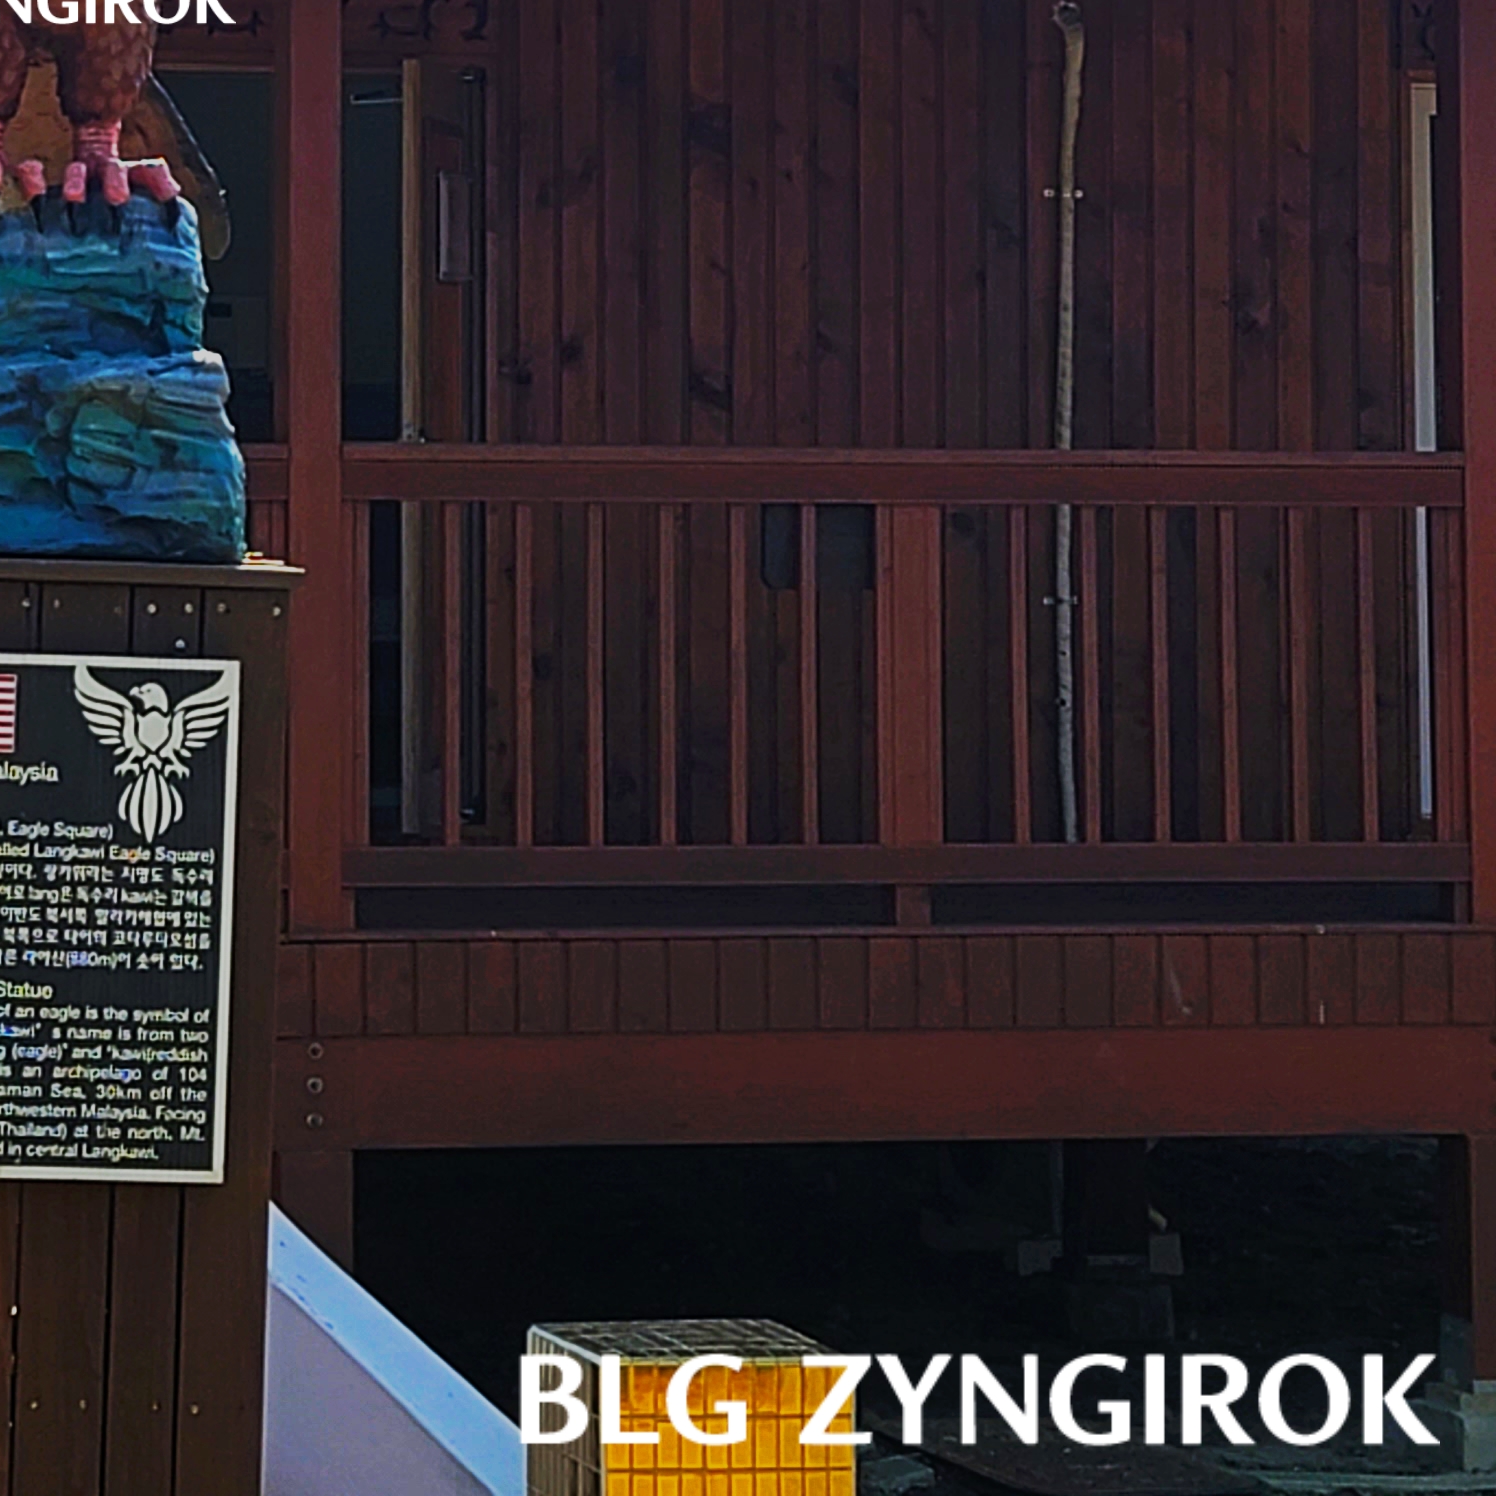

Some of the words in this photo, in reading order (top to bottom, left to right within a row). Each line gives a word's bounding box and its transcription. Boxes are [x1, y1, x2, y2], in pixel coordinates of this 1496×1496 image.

[8, 820, 50, 839] Eagle
[53, 822, 114, 841] Square)
[33, 843, 104, 862] Langkawi
[109, 845, 151, 864] Eagle
[155, 846, 215, 865] Square)
[14, 1007, 36, 1019] an
[39, 1005, 82, 1023] eagle
[85, 1006, 99, 1021] is
[103, 1007, 129, 1022] the
[132, 1008, 189, 1026] symbol
[193, 1009, 211, 1024] of
[66, 1028, 113, 1041] name
[117, 1027, 132, 1041] is
[137, 1027, 175, 1042] from
[180, 1029, 210, 1043] two
[71, 1045, 103, 1060] and
[22, 1066, 42, 1078] an
[52, 1064, 142, 1084] archipelago
[152, 1066, 169, 1081] of
[179, 1067, 208, 1083] 104
[96, 1085, 142, 1101] 30km
[149, 1087, 173, 1101] off
[181, 1087, 207, 1103] the
[155, 1106, 206, 1125] Facing
[73, 1125, 88, 1138] at
[96, 1125, 120, 1140] the
[7, 1142, 22, 1156] in
[25, 1143, 79, 1157] central
